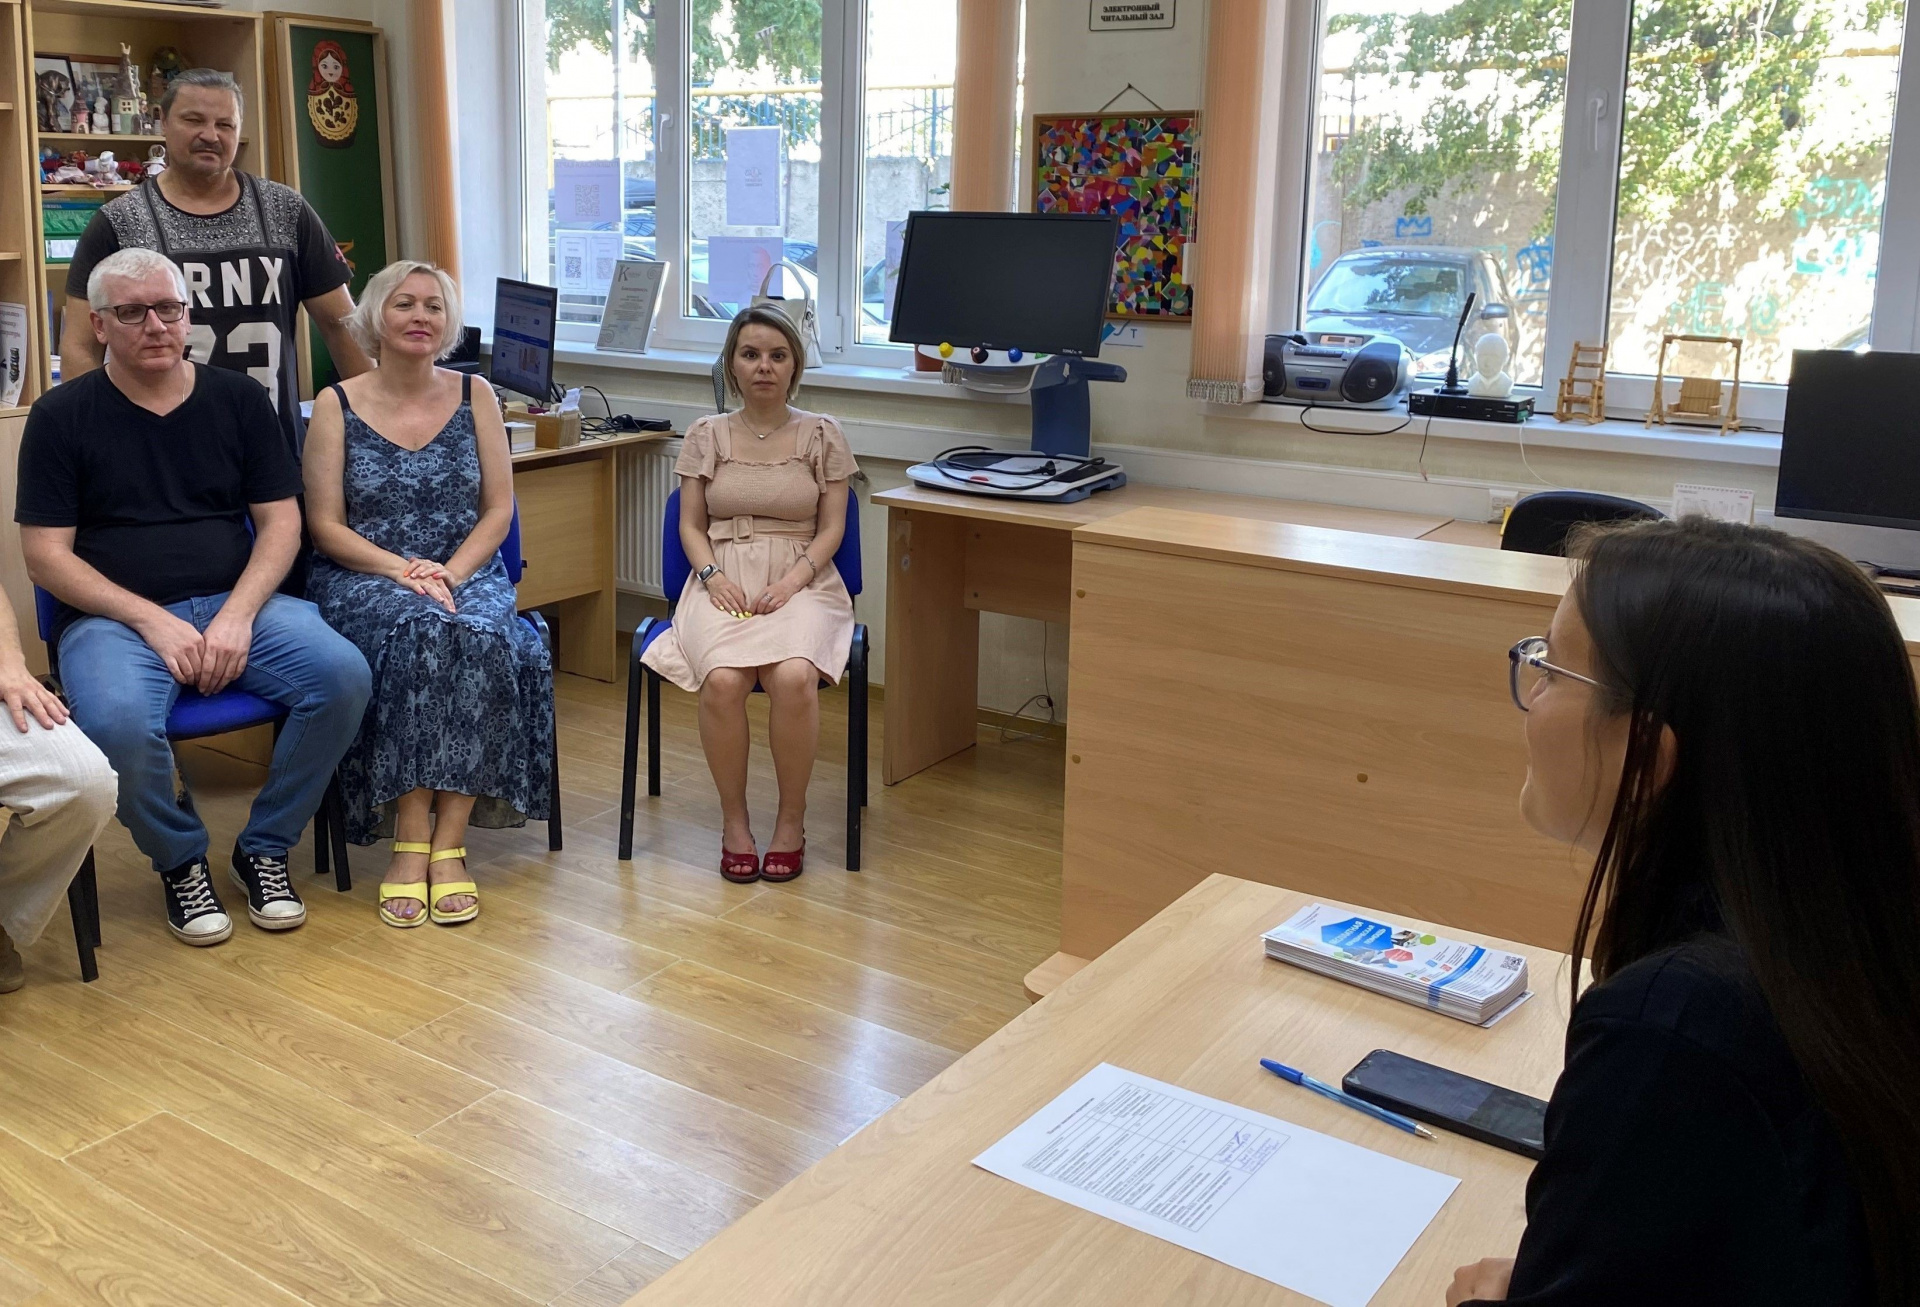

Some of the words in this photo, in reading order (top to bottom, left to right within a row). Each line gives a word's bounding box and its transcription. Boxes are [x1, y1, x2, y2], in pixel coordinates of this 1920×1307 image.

[1103, 3, 1160, 13] ЭЛЕКТРОННЫЙ
[1101, 13, 1148, 22] ЧИТАЛЬНЫЙ
[183, 256, 282, 308] RNX
